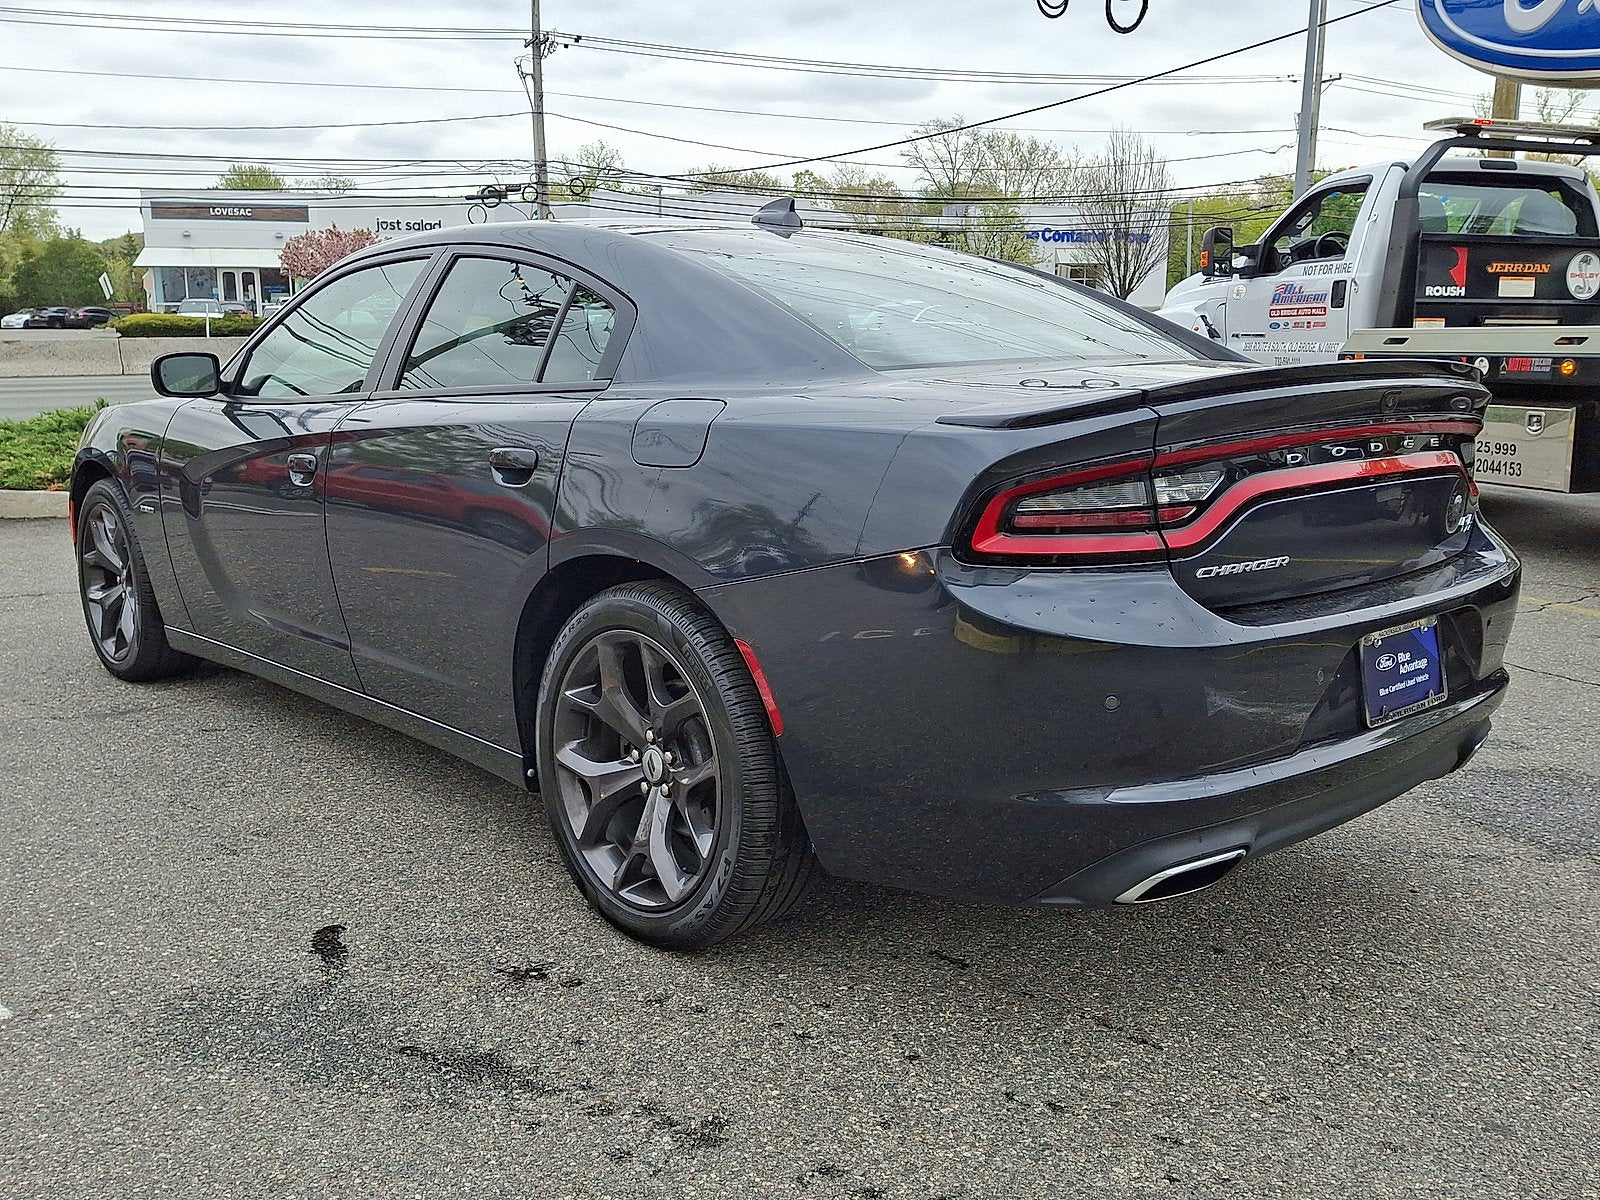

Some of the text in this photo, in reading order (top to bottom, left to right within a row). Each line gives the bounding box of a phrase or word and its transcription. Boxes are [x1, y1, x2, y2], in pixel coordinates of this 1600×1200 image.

[210, 207, 252, 217] LOVESAC
[405, 219, 442, 231] salad
[1303, 262, 1353, 276] NOT FOR HIRE
[1283, 283, 1305, 295] ALL
[1425, 285, 1466, 297] ROUSH
[1271, 293, 1328, 304] AMERICAN
[1270, 309, 1281, 317] OLD
[1298, 308, 1312, 316] AUTO
[1286, 438, 1439, 464] DODGE
[1476, 440, 1517, 456] 25,999
[1475, 458, 1523, 477] 2044153
[1195, 555, 1290, 579] CHARGER
[1397, 651, 1411, 664] Blue
[1399, 657, 1428, 675] Advantage
[1379, 687, 1390, 697] Blue
